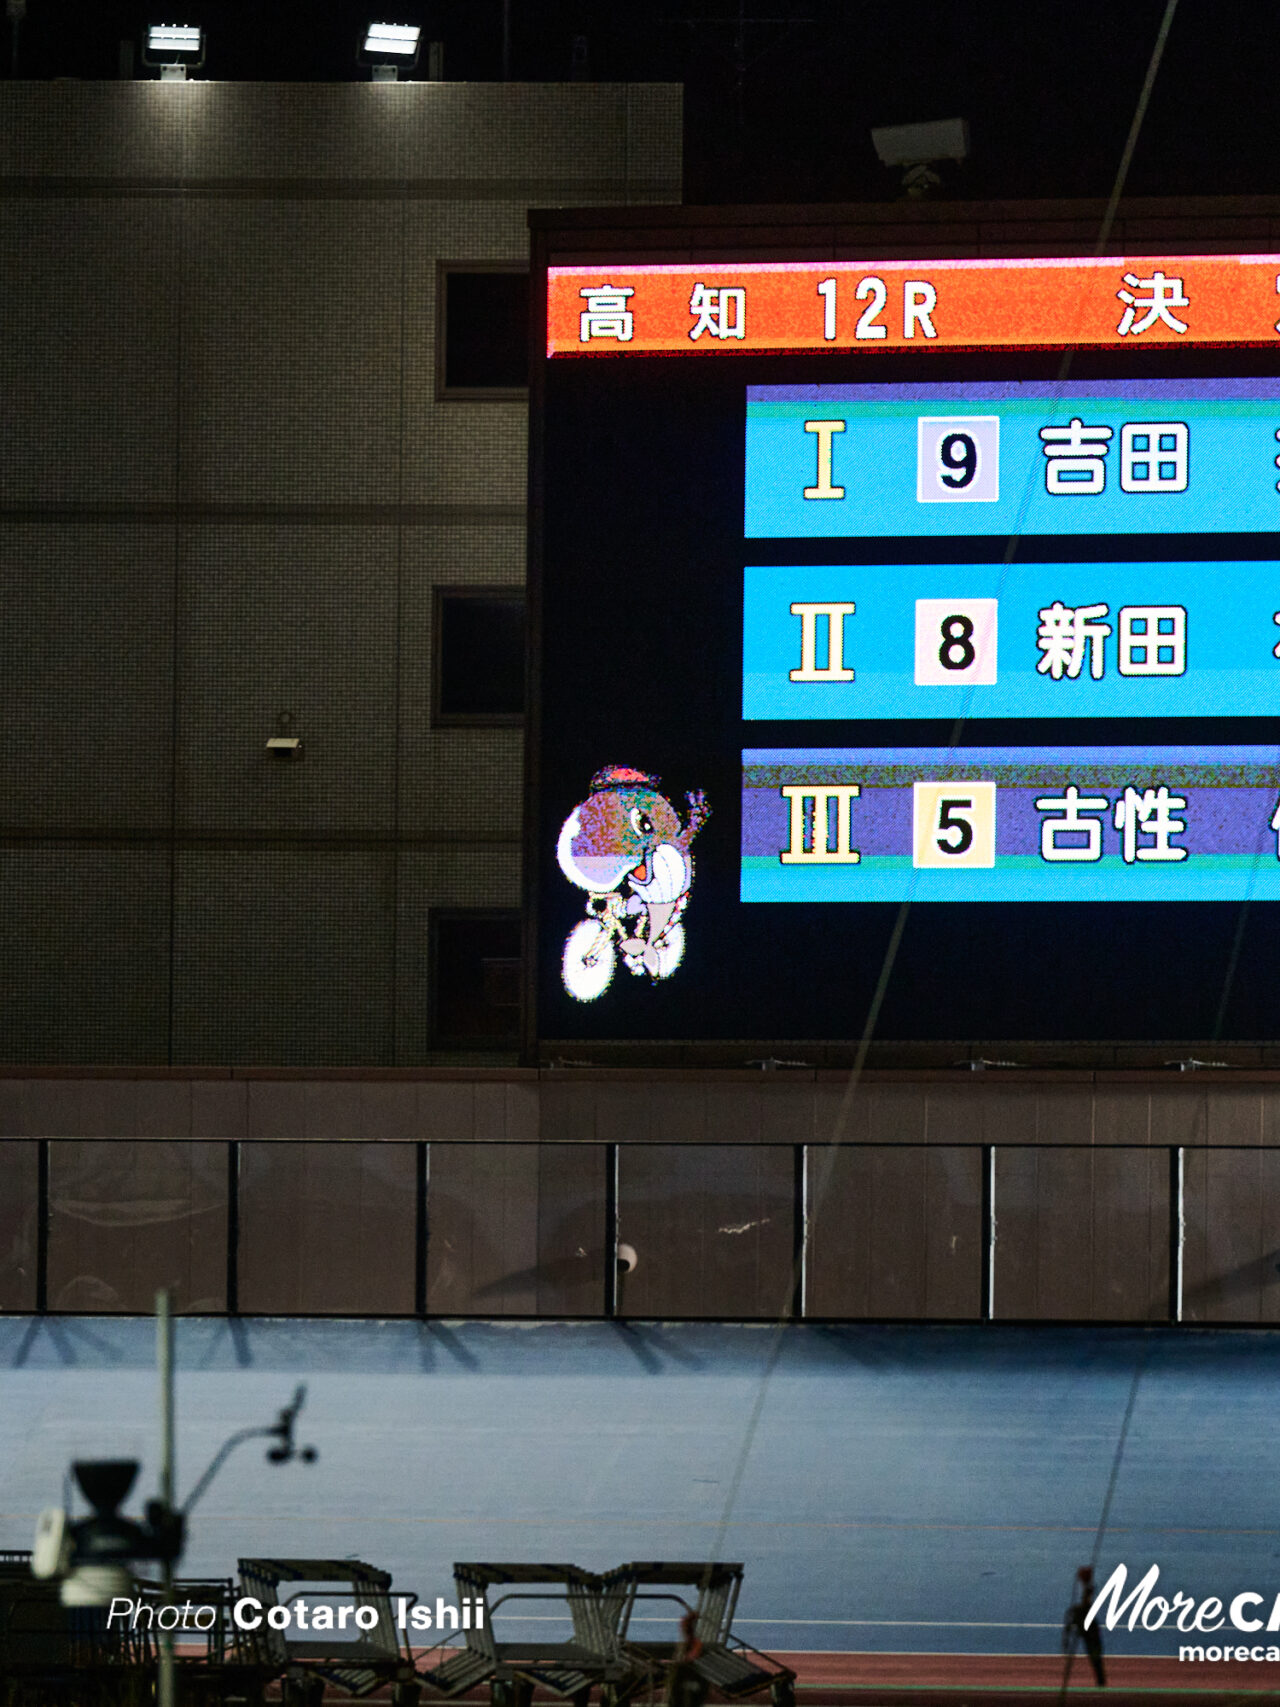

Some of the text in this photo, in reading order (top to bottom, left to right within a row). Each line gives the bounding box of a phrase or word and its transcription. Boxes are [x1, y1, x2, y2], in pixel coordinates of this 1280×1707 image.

[580, 283, 746, 342] 高知
[818, 276, 938, 341] 12R
[940, 432, 979, 489] 9
[938, 614, 976, 671] 8
[936, 799, 974, 855] 5
